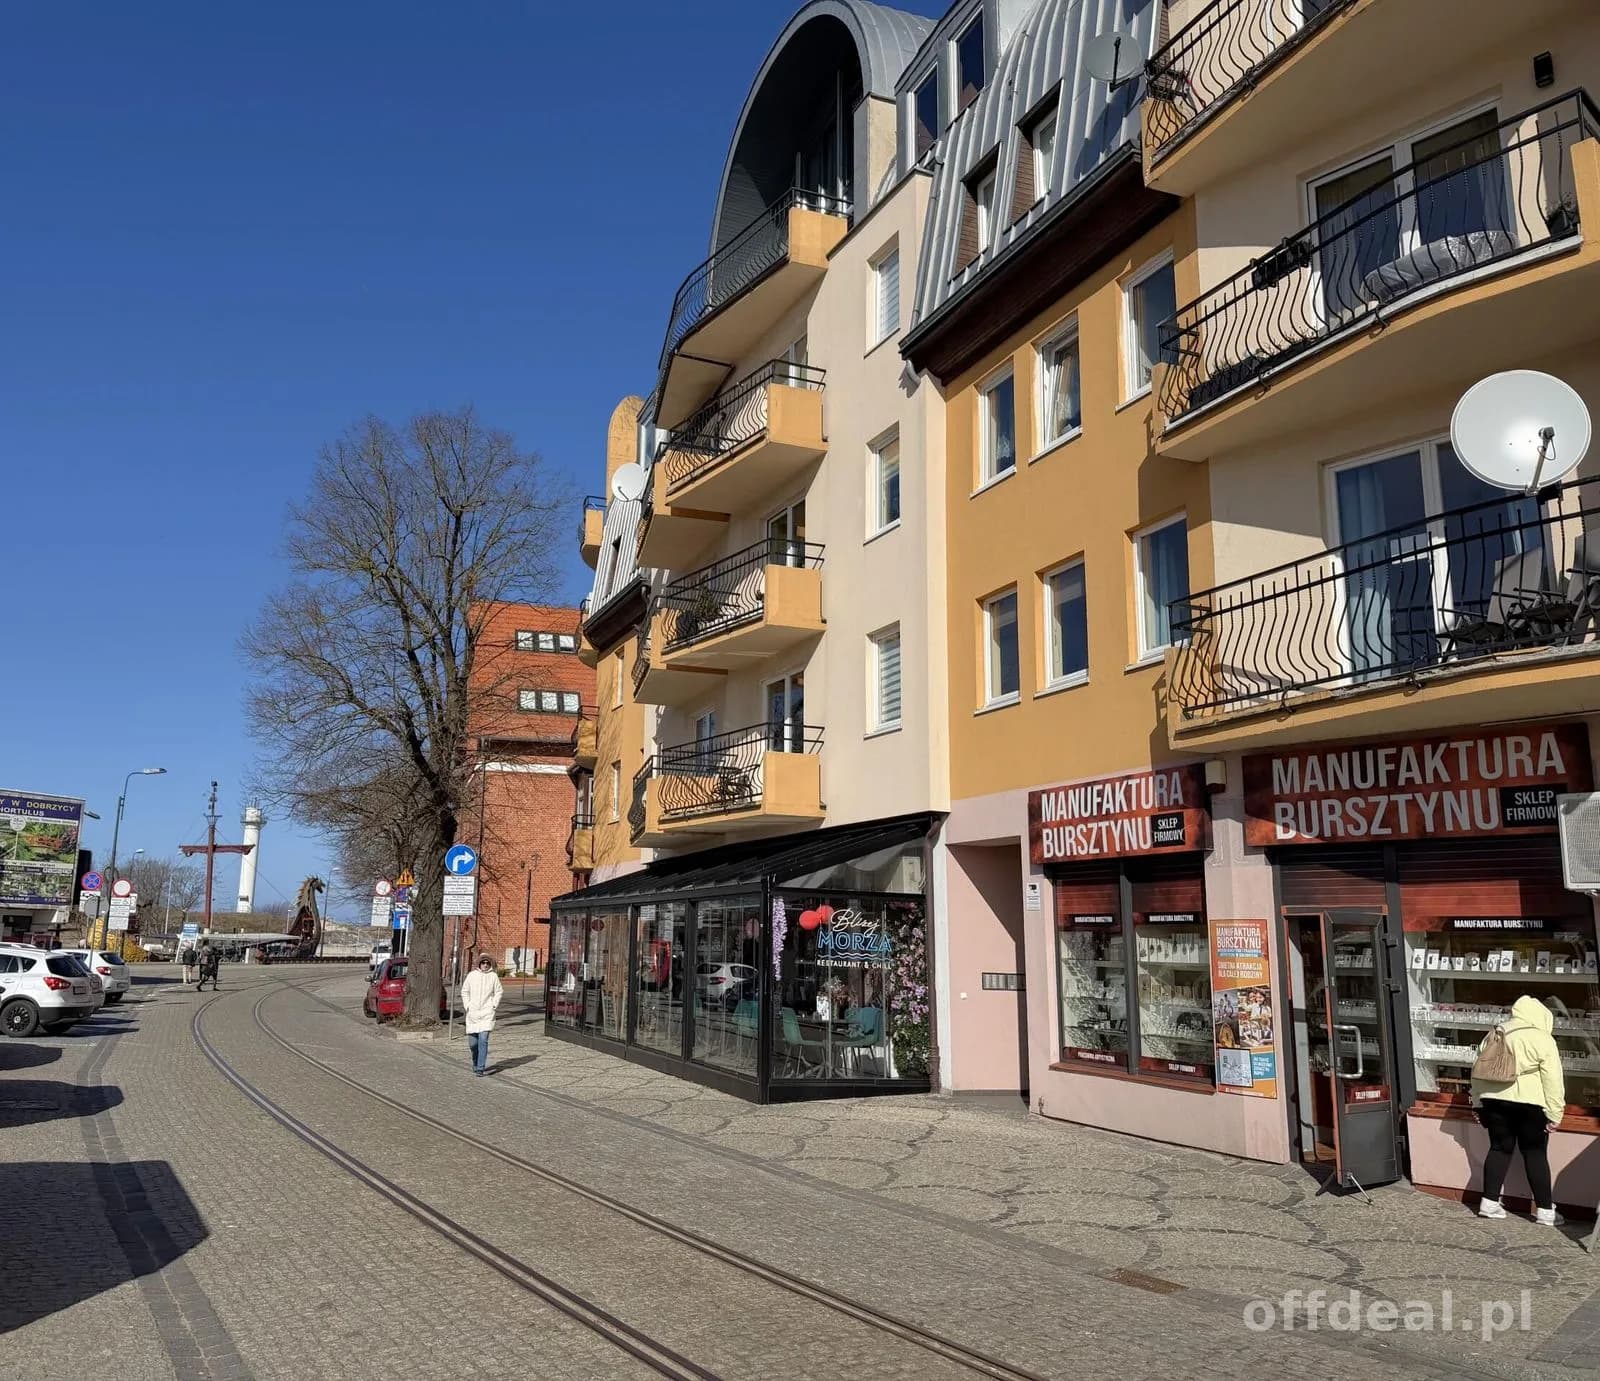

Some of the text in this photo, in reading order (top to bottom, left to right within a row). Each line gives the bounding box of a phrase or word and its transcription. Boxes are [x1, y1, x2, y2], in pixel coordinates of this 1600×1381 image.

[1272, 732, 1567, 796] MANUFAKTURA
[1041, 771, 1184, 823] MANUFAKTURA
[1514, 790, 1555, 805] SKLEP
[27, 801, 75, 812] DOBRZYCY
[1275, 787, 1499, 840] BURSZTYNU
[1506, 805, 1557, 822] FIRMOW
[1157, 817, 1178, 830] SKLEP
[1042, 815, 1151, 858] BURSZTYNU
[1153, 829, 1184, 843] FIRMOWY
[1454, 919, 1543, 928] MANUFAKTURA BURSZTYNU
[1216, 927, 1260, 937] MANUFAKTURA
[818, 930, 892, 952] MORZA
[1217, 937, 1261, 948] BURSZTYNU
[817, 960, 860, 968] RESTAURANT
